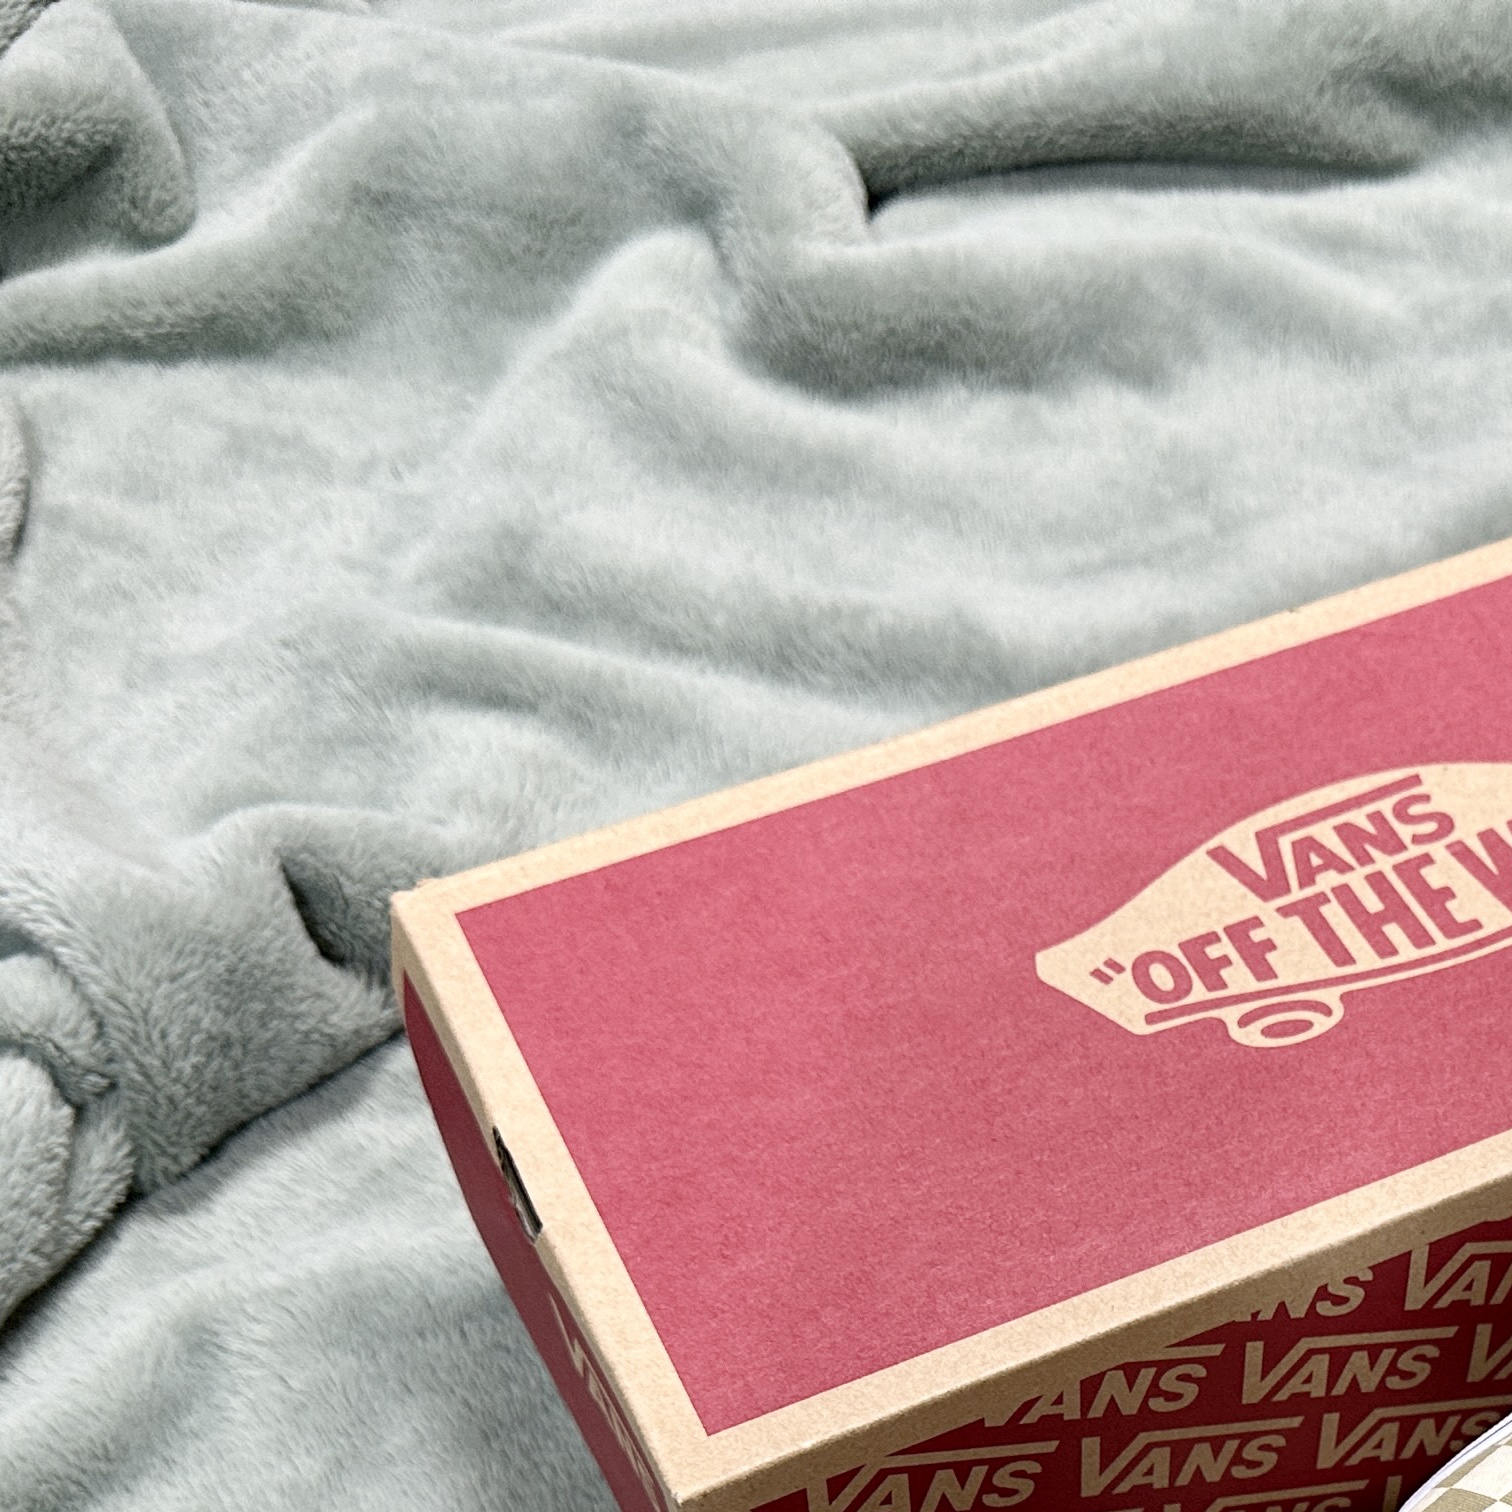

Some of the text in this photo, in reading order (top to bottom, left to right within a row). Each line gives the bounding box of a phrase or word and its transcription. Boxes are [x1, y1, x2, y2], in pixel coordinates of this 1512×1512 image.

[1207, 774, 1456, 903] VANS
[1089, 919, 1279, 1004] "OFF
[1277, 854, 1484, 967] THE
[1241, 1325, 1459, 1406] VANS
[1080, 1415, 1304, 1499] VANS
